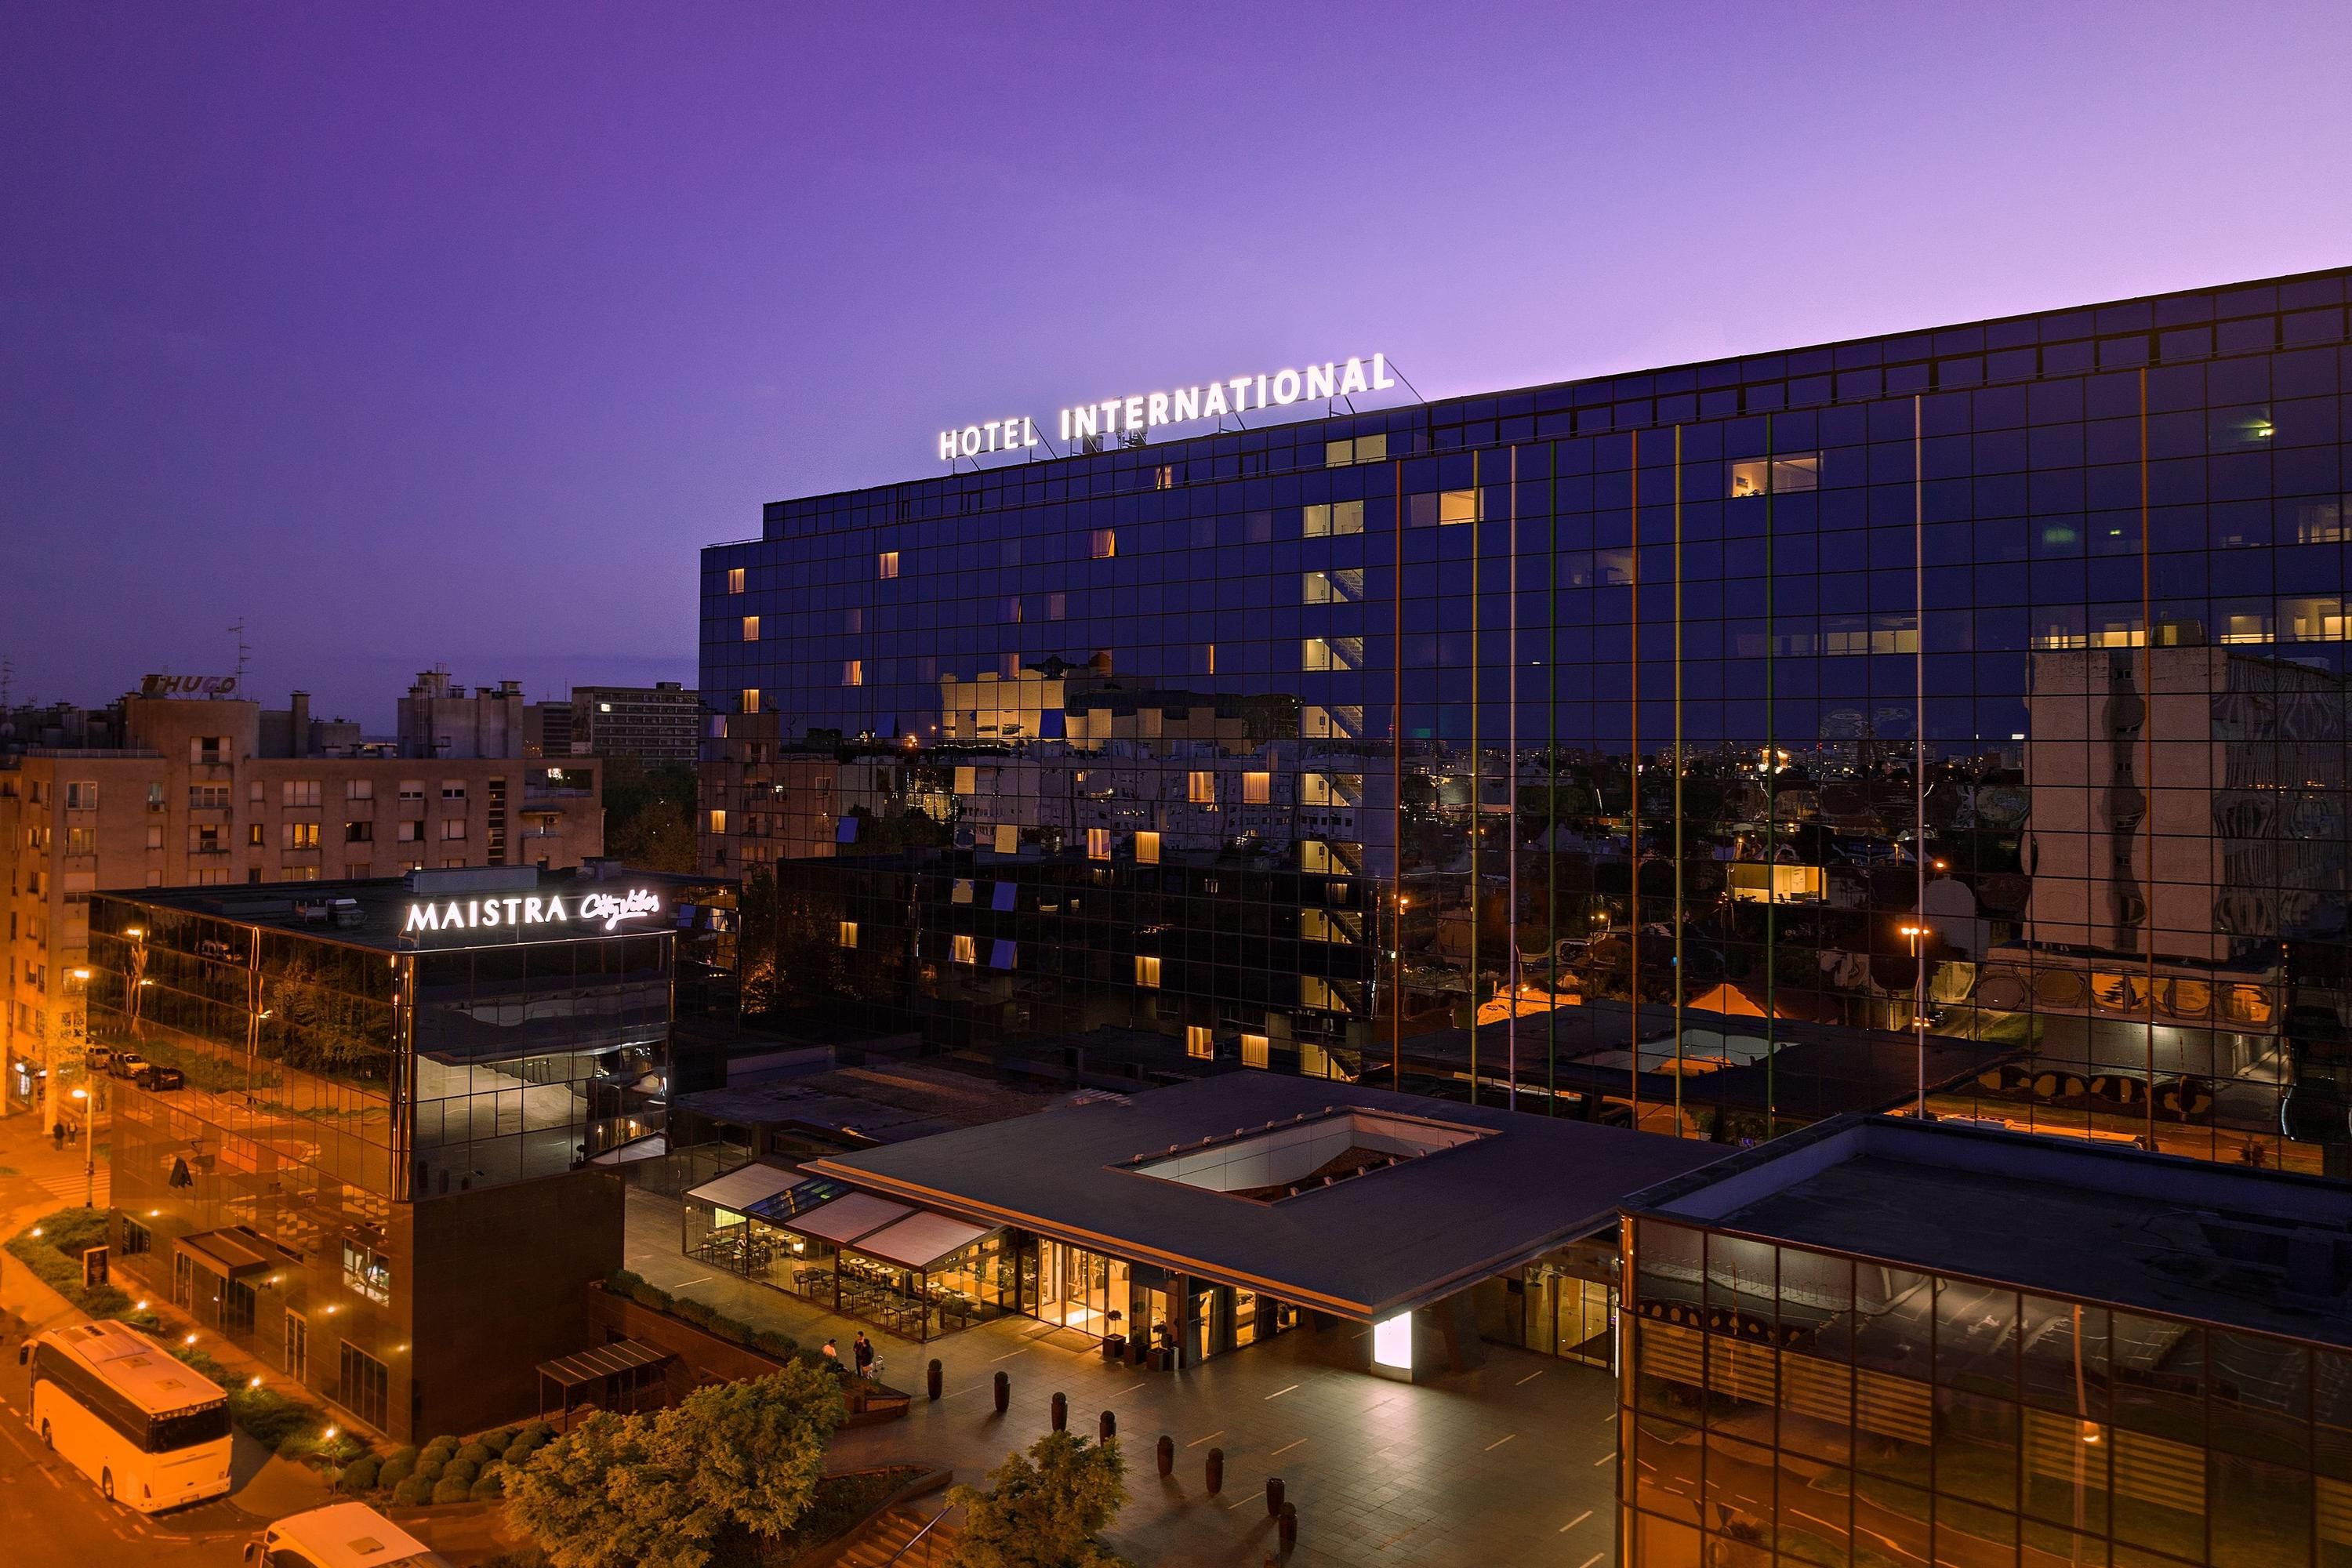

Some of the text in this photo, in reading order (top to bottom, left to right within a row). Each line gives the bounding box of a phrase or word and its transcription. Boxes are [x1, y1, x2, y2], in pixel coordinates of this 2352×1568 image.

[940, 352, 1395, 460] HOTEL INTERNATIONAL
[162, 676, 235, 694] HUGO
[406, 895, 568, 932] MAISTRA
